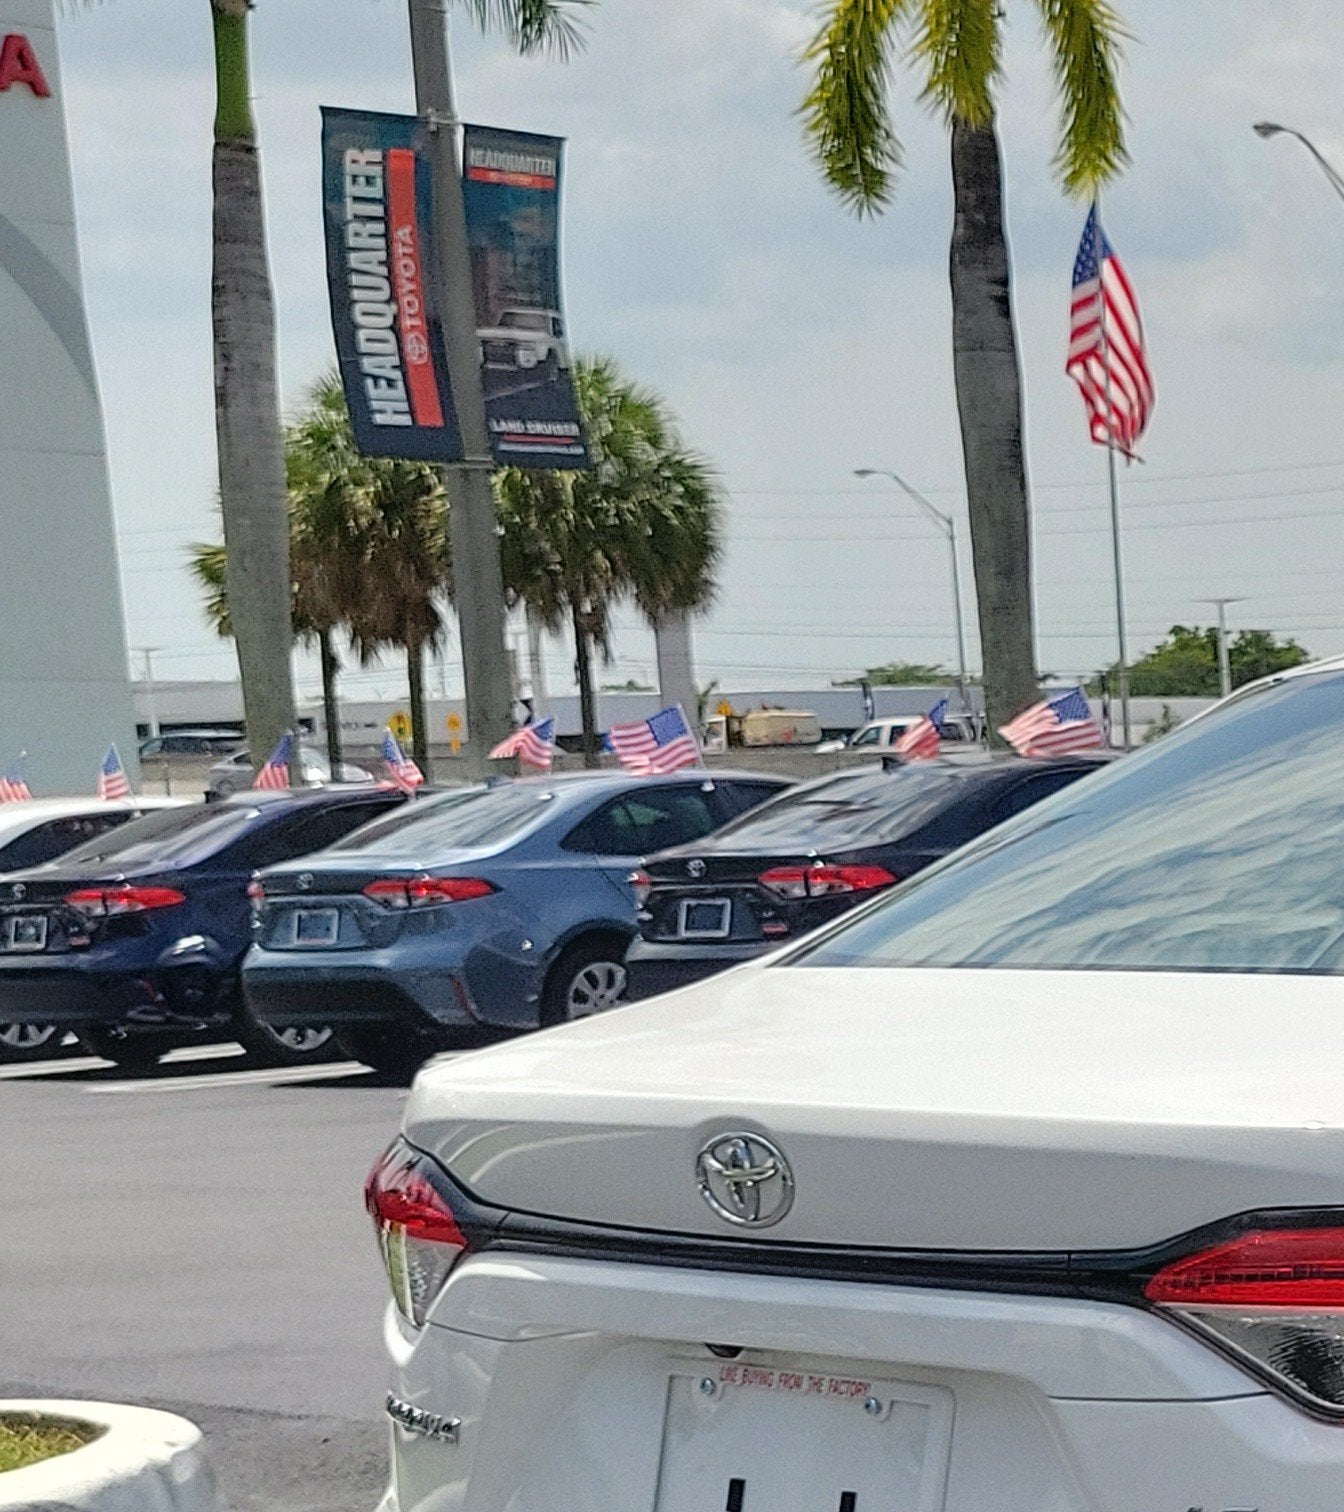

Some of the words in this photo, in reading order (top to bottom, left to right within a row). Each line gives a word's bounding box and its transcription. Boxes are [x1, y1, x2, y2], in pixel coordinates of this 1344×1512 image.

[344, 148, 413, 426] HEADQUARTER
[396, 225, 420, 329] TOYOTA
[778, 1371, 804, 1391] FROM
[807, 1375, 826, 1394] THE
